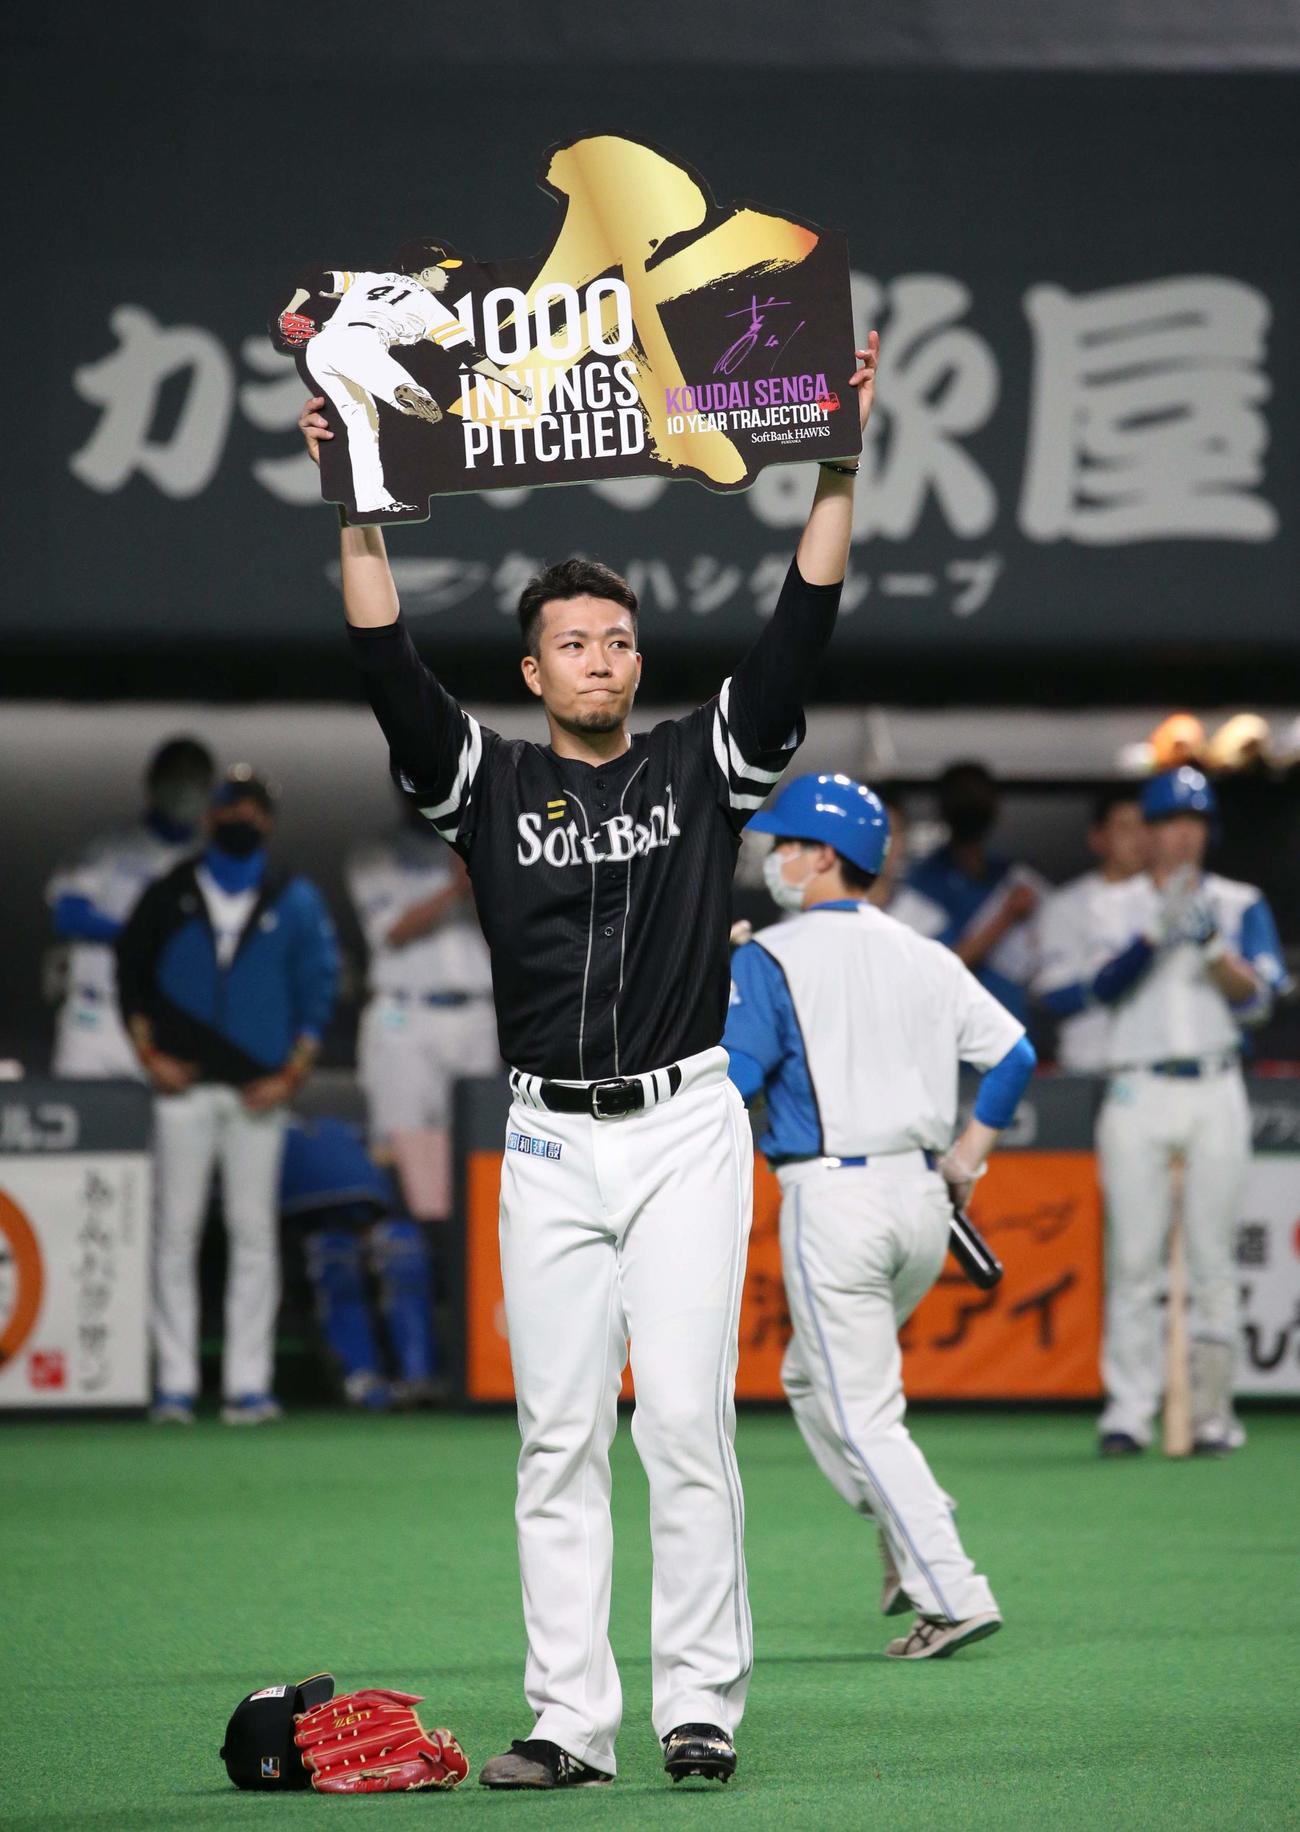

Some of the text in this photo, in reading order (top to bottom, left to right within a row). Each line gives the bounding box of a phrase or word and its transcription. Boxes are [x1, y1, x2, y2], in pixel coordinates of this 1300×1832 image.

[453, 278, 634, 368] 1000
[458, 361, 640, 420] INNINGS
[665, 373, 830, 415] KOUDAI SENGA
[461, 408, 645, 469] PITCHED
[666, 402, 829, 435] 10 YEAR TRAJECTORY
[751, 425, 831, 444] SoftBank HAWKS
[334, 1711, 373, 1729] ZETT
